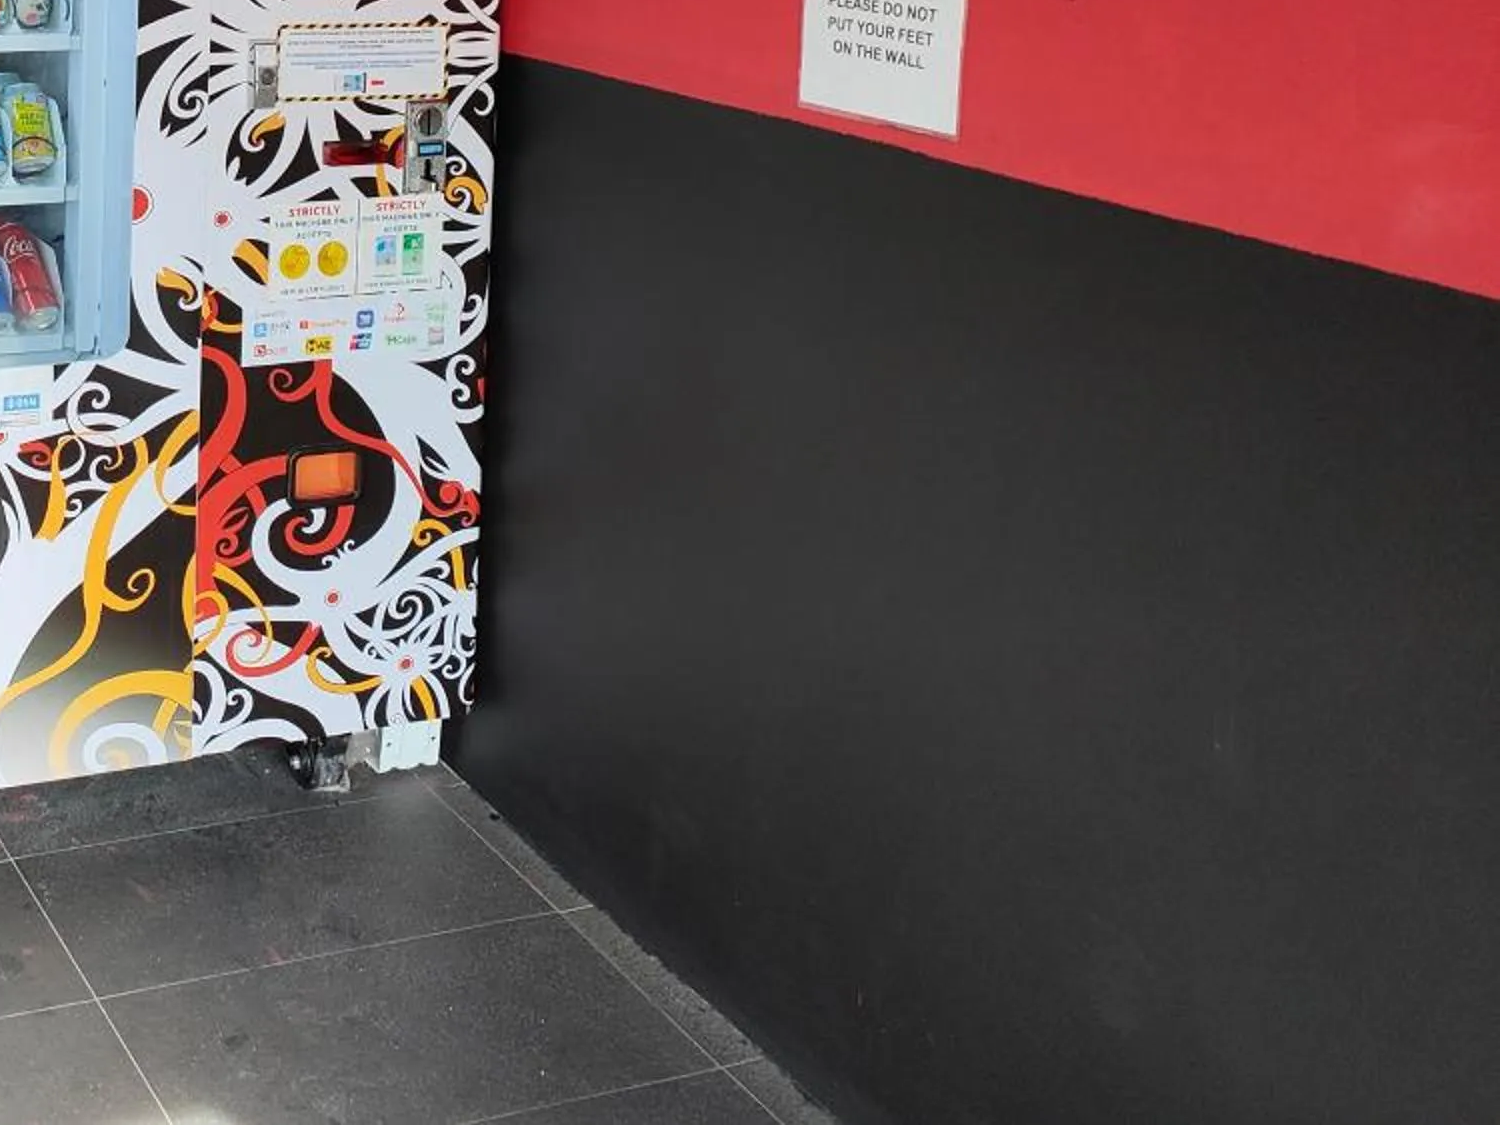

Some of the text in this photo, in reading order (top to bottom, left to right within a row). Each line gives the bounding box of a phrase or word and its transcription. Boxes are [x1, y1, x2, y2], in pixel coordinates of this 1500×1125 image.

[883, 2, 902, 17] DO
[906, 5, 937, 23] NOT
[827, 17, 933, 46] PUT YOUR FEET
[833, 39, 925, 69] ON THE WALL
[289, 205, 341, 218] STRICTLY
[376, 200, 426, 212] STRICTLY
